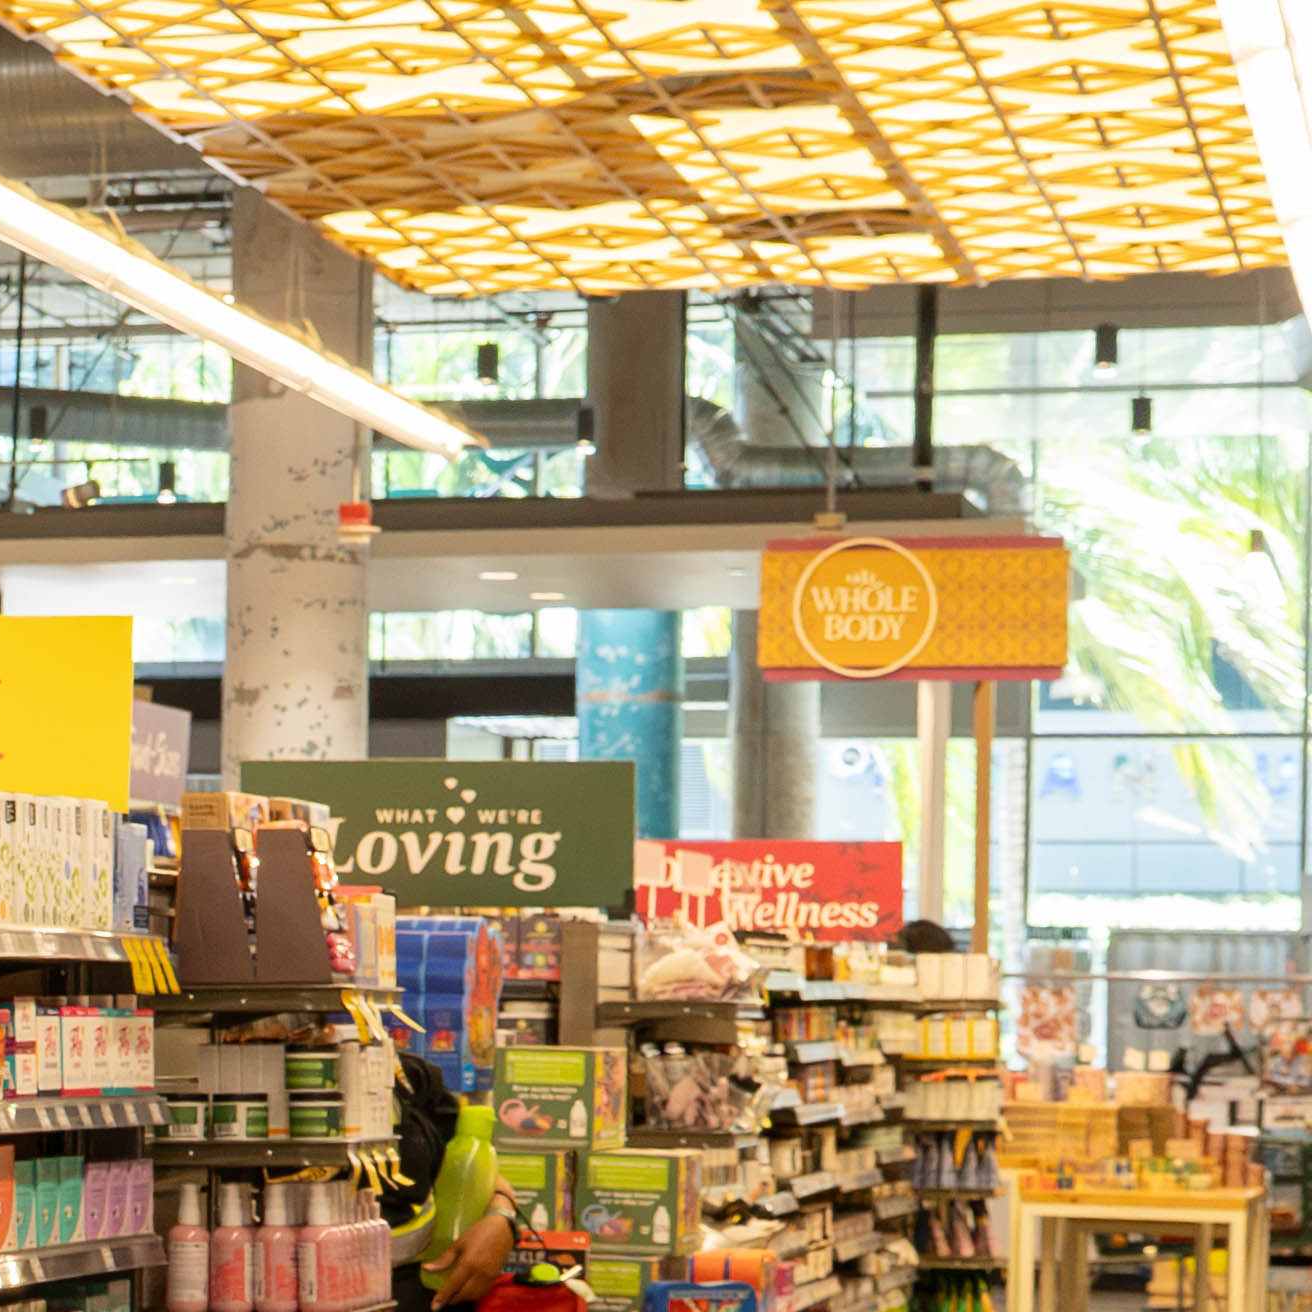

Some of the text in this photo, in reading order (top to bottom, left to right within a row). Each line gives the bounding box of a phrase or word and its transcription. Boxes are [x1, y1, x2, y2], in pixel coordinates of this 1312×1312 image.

[810, 586, 918, 614] WHOLE
[823, 613, 906, 641] BODY
[375, 808, 543, 824] WHAT WE'RE
[327, 816, 561, 892] Loving
[726, 892, 879, 930] Wellness
